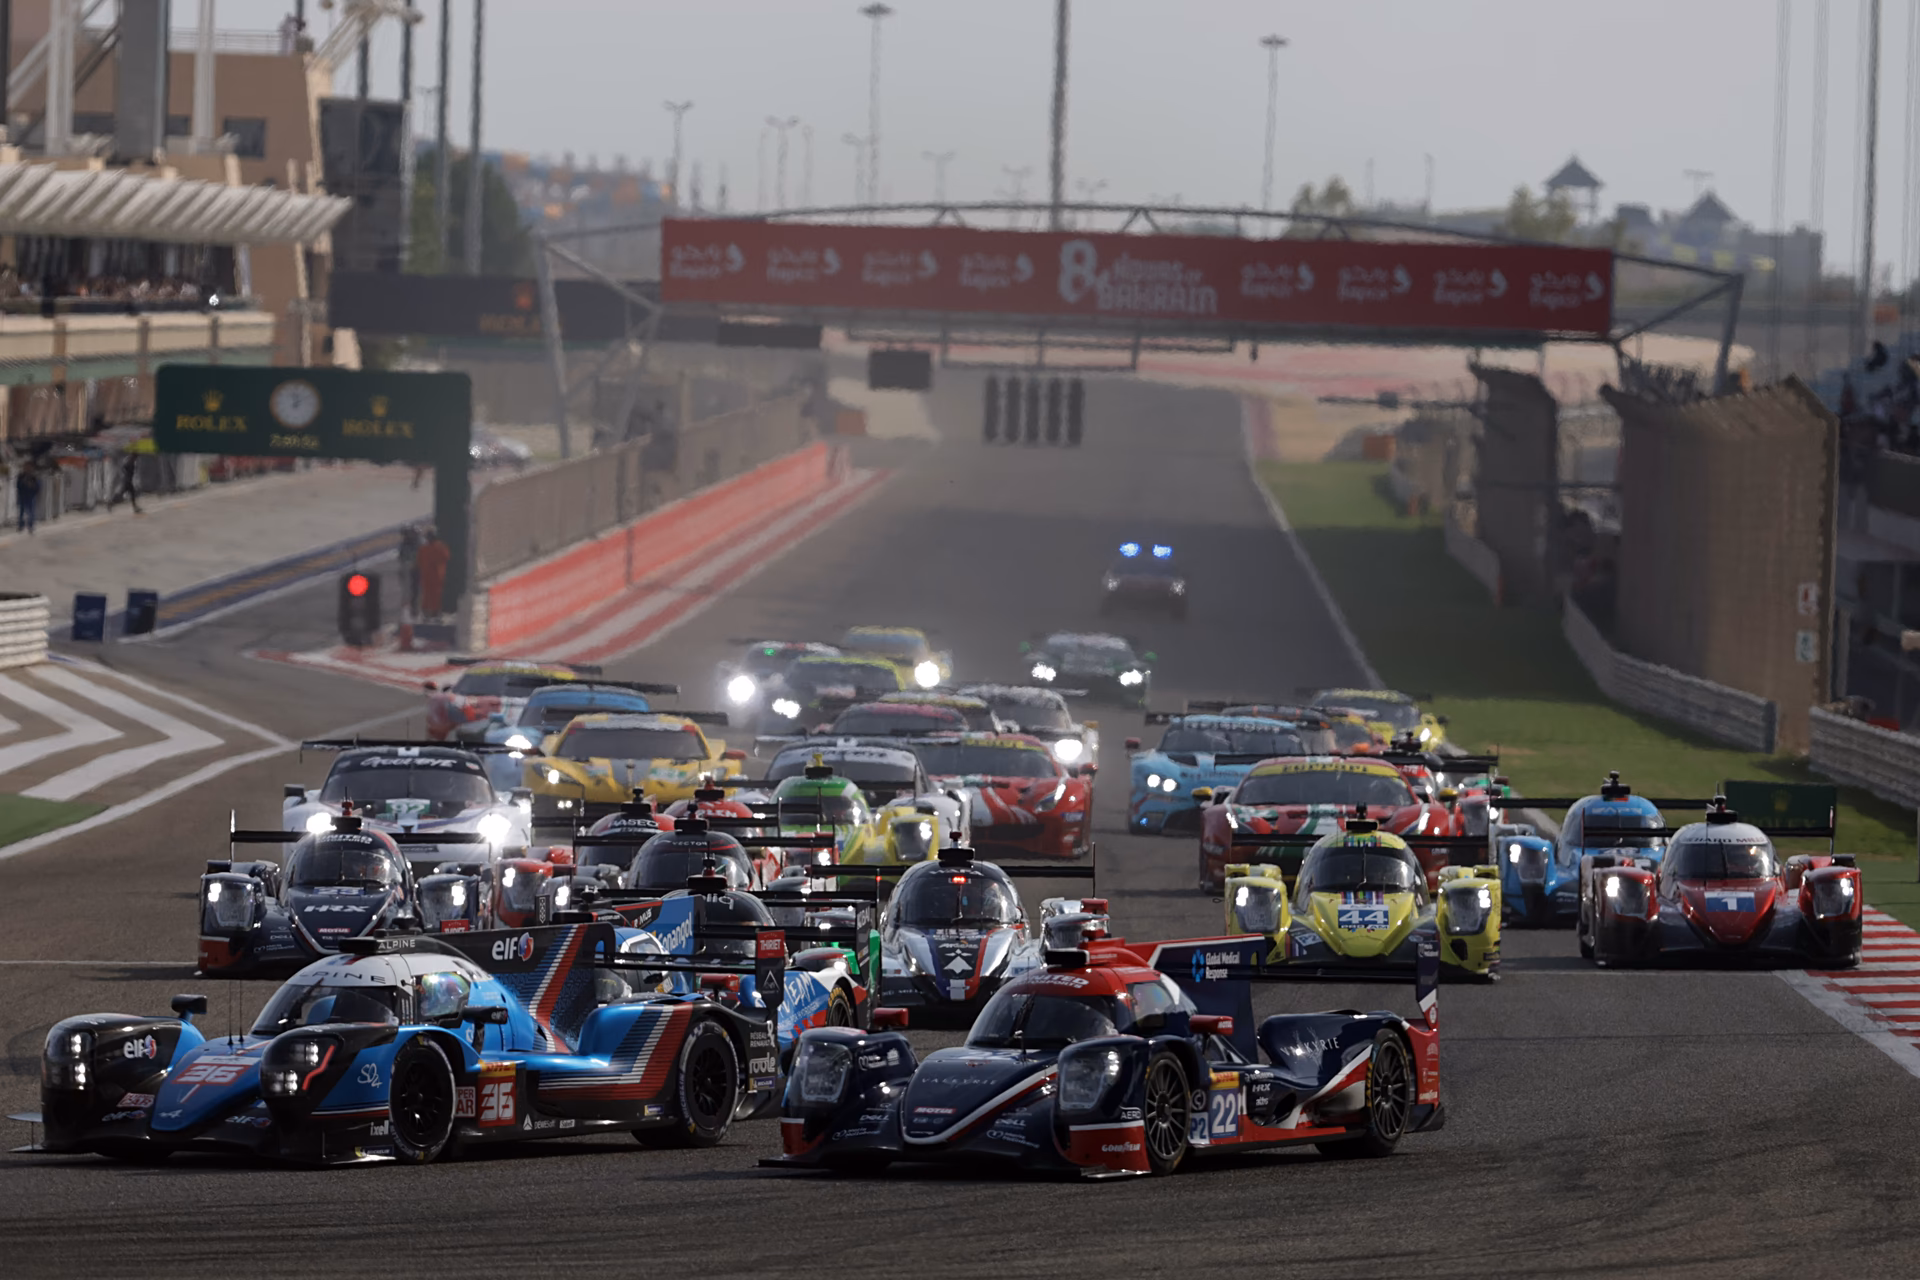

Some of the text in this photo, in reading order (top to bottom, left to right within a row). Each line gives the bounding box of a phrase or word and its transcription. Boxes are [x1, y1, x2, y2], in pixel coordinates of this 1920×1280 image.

[1059, 239, 1098, 304] 8
[176, 413, 248, 433] ROLEX
[1721, 896, 1738, 911] 1
[1339, 910, 1388, 924] 44
[378, 939, 416, 950] ALPINE
[491, 936, 518, 962] elf
[1205, 951, 1241, 965] Global Medical
[1205, 966, 1229, 982] Response
[123, 1038, 147, 1060] elf
[175, 1064, 244, 1083] 36
[480, 1082, 514, 1121] 36
[1211, 1093, 1237, 1134] 22
